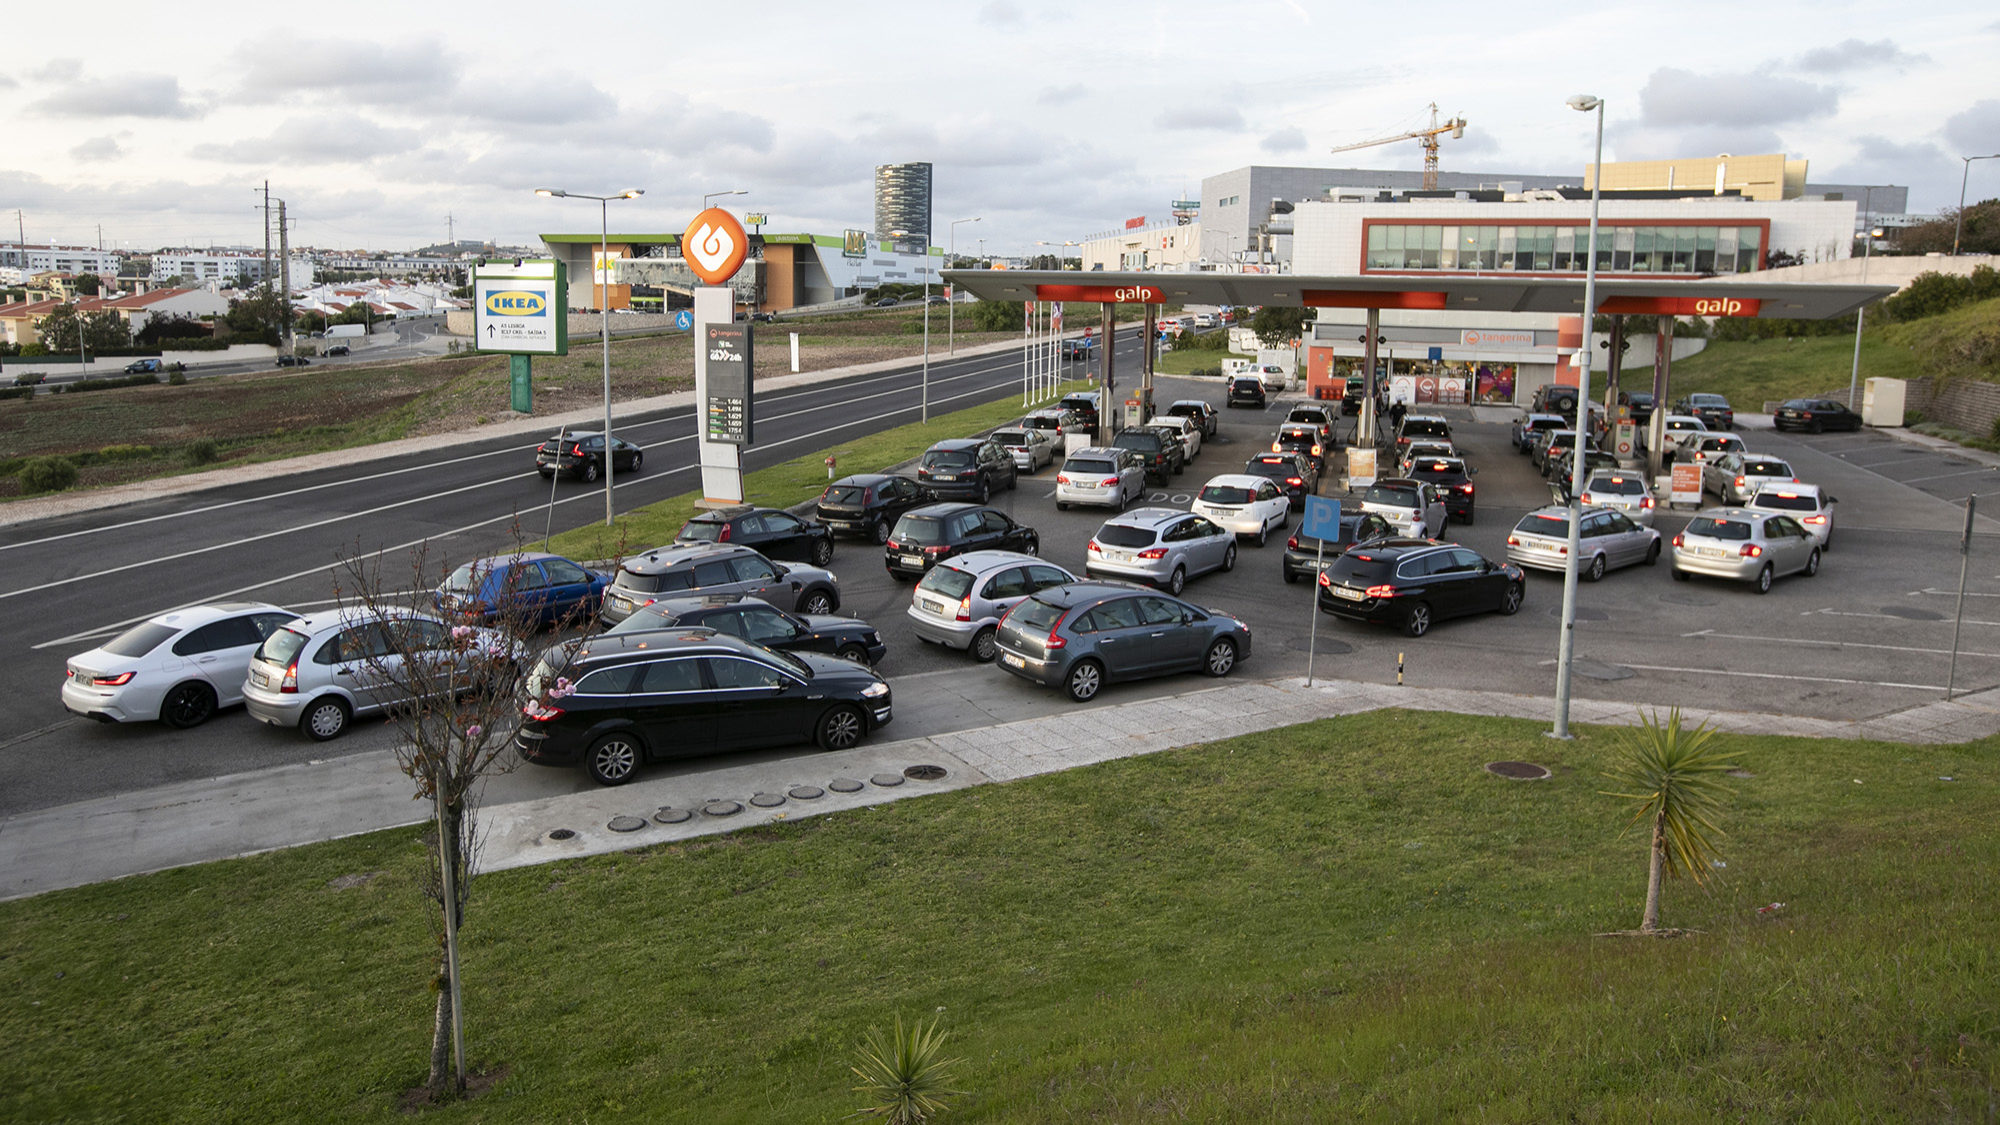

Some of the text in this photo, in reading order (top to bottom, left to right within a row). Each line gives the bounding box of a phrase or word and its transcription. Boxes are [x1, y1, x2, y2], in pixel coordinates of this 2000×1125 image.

[1114, 285, 1152, 303] galp
[494, 298, 540, 309] IKEA
[1695, 297, 1742, 316] galp
[1482, 333, 1532, 344] tangerina
[1311, 502, 1332, 532] P
